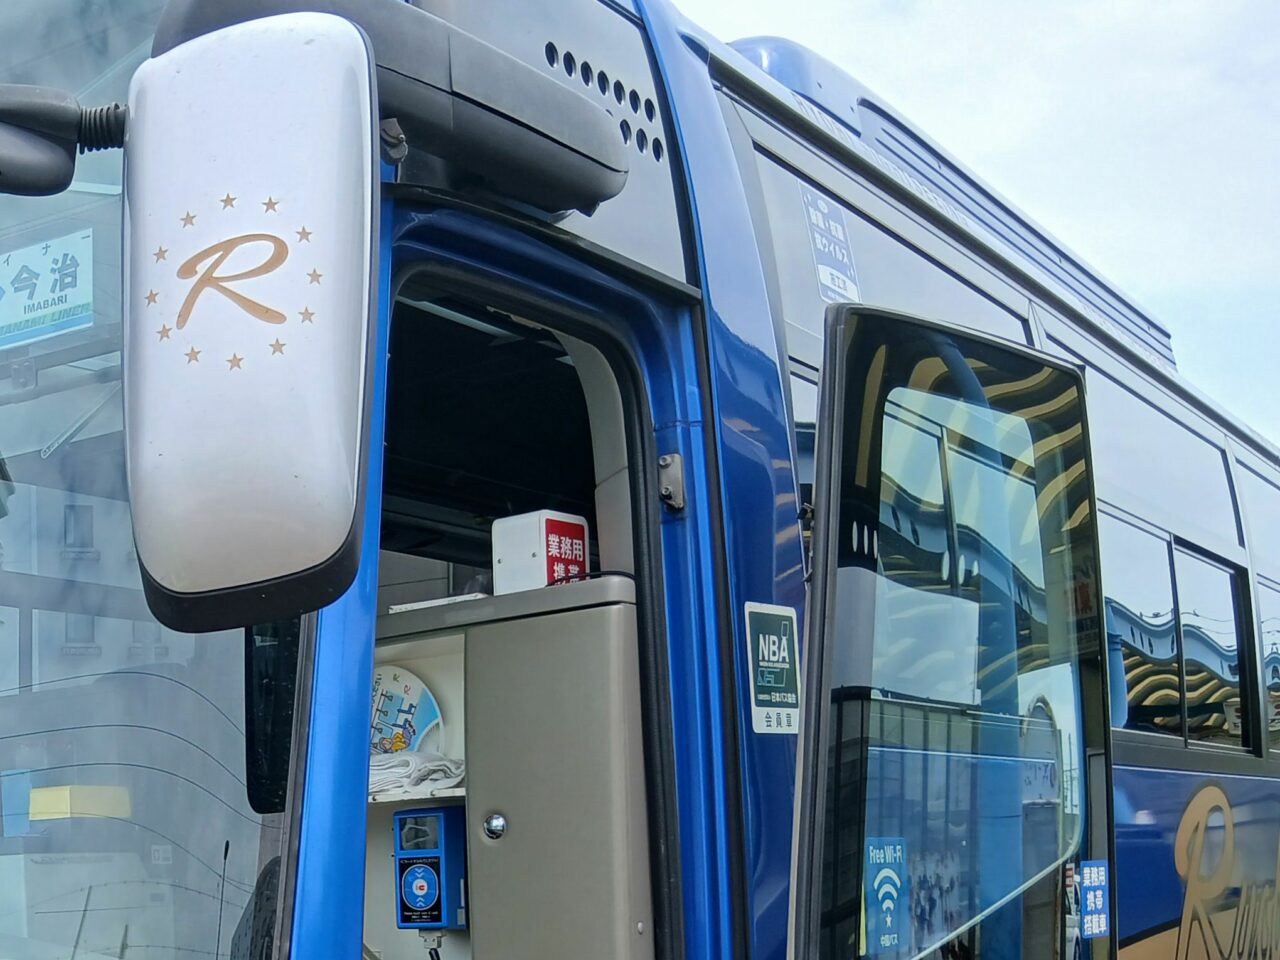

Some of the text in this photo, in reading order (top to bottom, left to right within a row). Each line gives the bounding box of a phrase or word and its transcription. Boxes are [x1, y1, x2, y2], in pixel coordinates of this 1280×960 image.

[10, 252, 80, 301] 今治
[176, 233, 289, 331] R
[23, 293, 68, 315] IMABARI
[51, 302, 91, 322] LINER
[548, 533, 584, 562] 業務用
[758, 633, 790, 662] NBA
[869, 845, 903, 864] Free Wi-Fi
[1083, 866, 1106, 887] 業務用
[1086, 890, 1103, 912] 携帯
[1084, 914, 1107, 936] 搭載車
